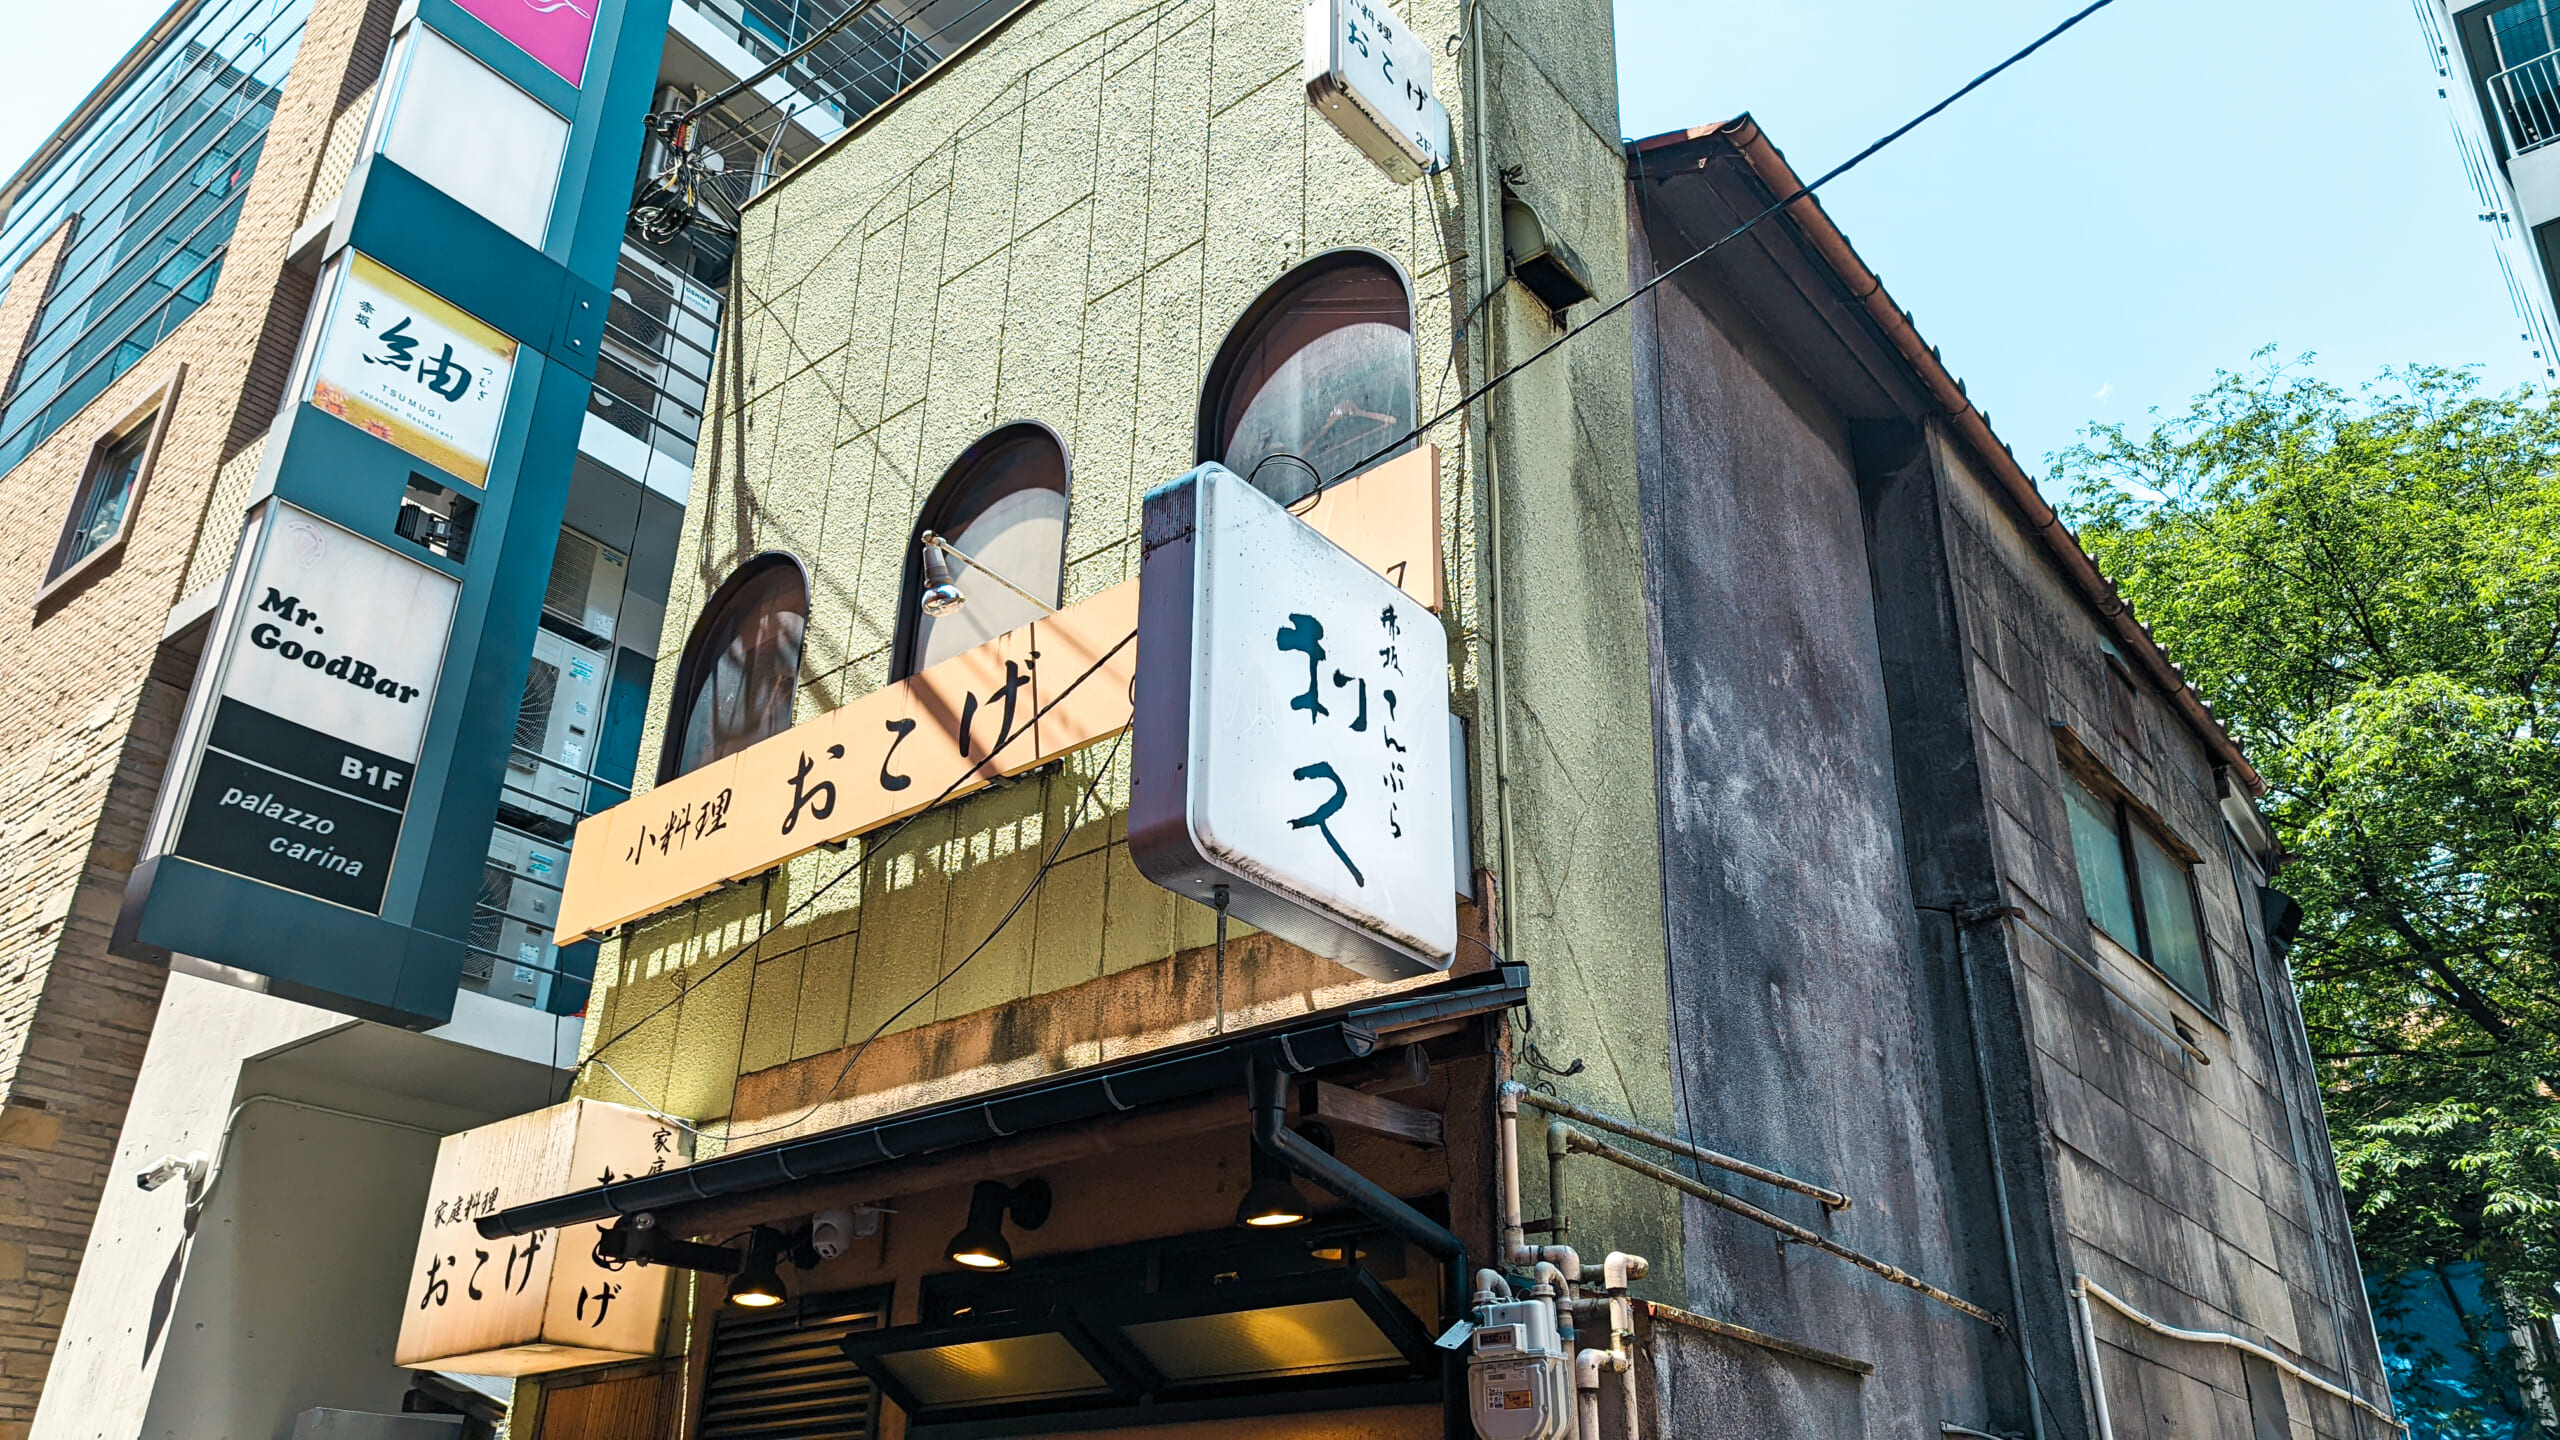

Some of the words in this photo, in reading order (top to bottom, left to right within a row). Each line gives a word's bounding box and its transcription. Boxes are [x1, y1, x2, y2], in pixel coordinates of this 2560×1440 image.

[1348, 19, 1428, 111] おこげ
[355, 300, 376, 329] 赤坂
[683, 286, 711, 305] OSHIBA
[362, 316, 472, 403] 紬
[381, 384, 442, 421] TSUMUGI
[477, 367, 494, 402] つむぎ
[359, 388, 399, 413] Japanese
[406, 412, 454, 441] Restaurant
[258, 586, 324, 635] Mr.
[251, 622, 420, 704] GoodBar
[340, 755, 404, 792] B1F
[626, 788, 732, 866] 小料理
[781, 651, 1041, 836] おこげ
[219, 787, 335, 835] palazzo
[269, 837, 364, 877] carina
[434, 1187, 499, 1229] 家庭料理
[421, 1229, 547, 1310] おこげ
